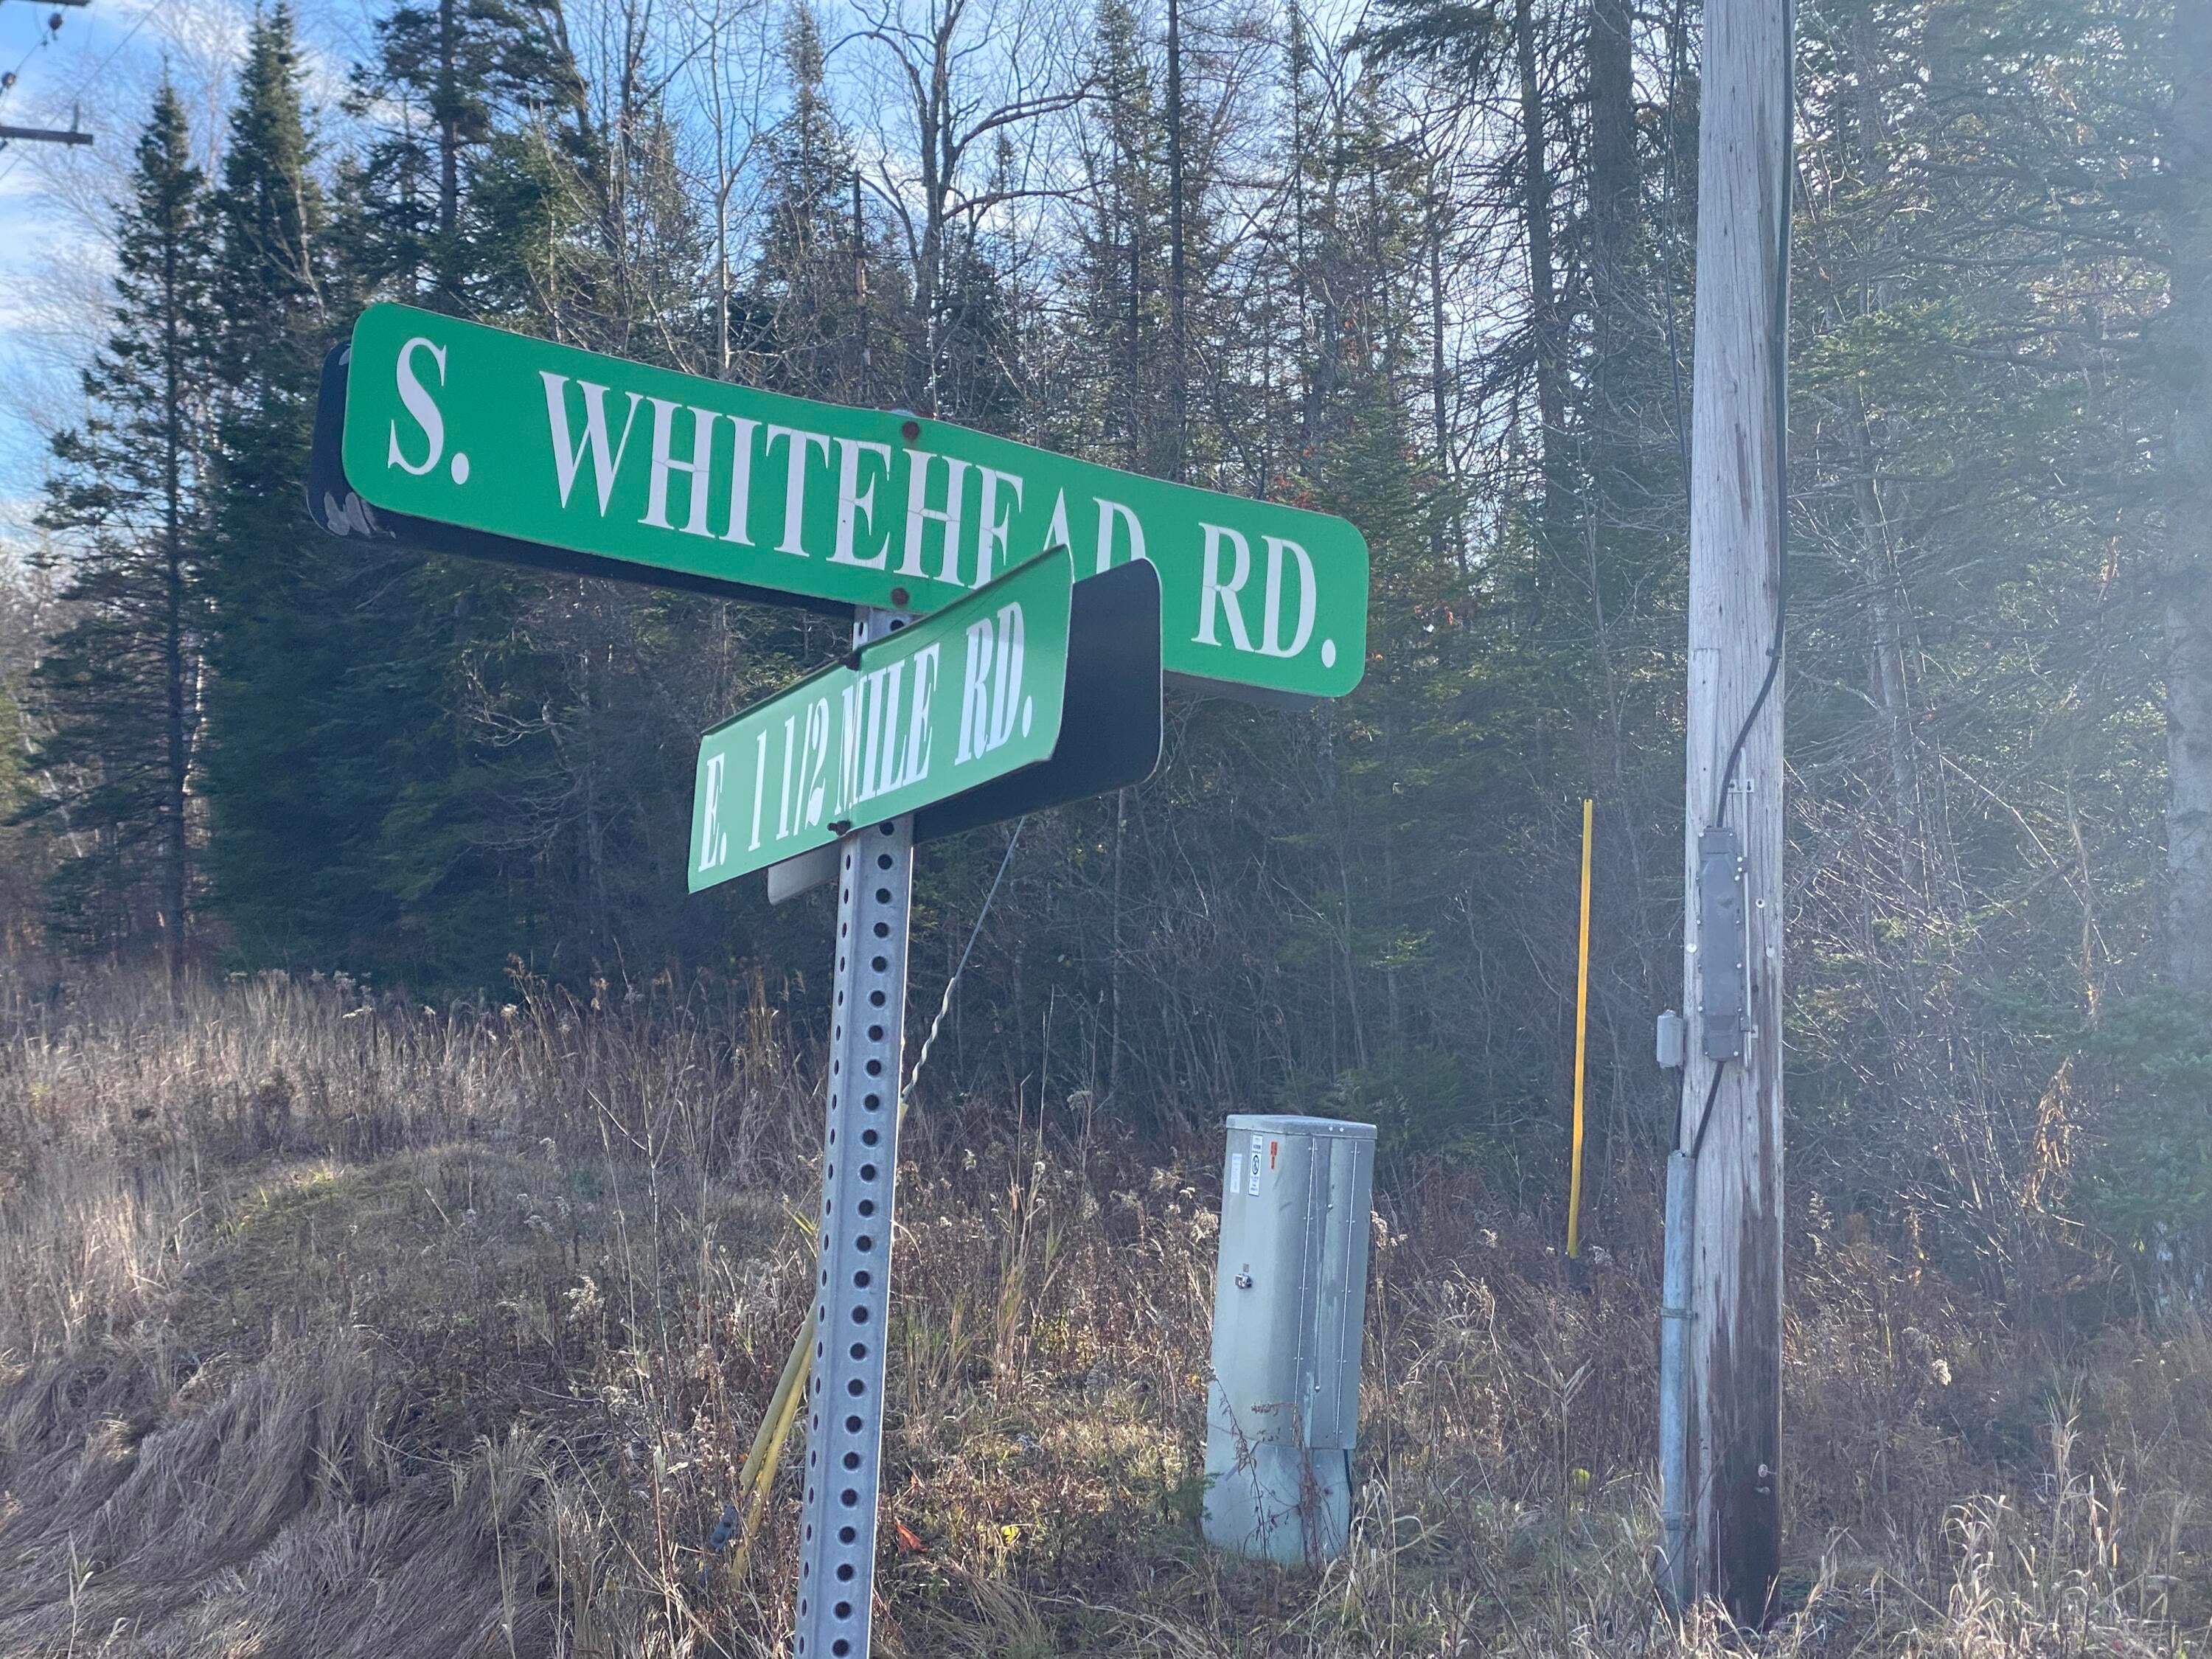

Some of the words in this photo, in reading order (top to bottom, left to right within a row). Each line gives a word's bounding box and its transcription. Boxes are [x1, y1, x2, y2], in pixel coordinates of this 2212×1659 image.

[388, 337, 470, 485] S.
[1192, 522, 1336, 668] RD.
[698, 752, 727, 872] E.
[748, 730, 767, 852] 1
[776, 697, 828, 840] 1/2
[834, 643, 939, 815] MILE
[954, 602, 1032, 765] RD.
